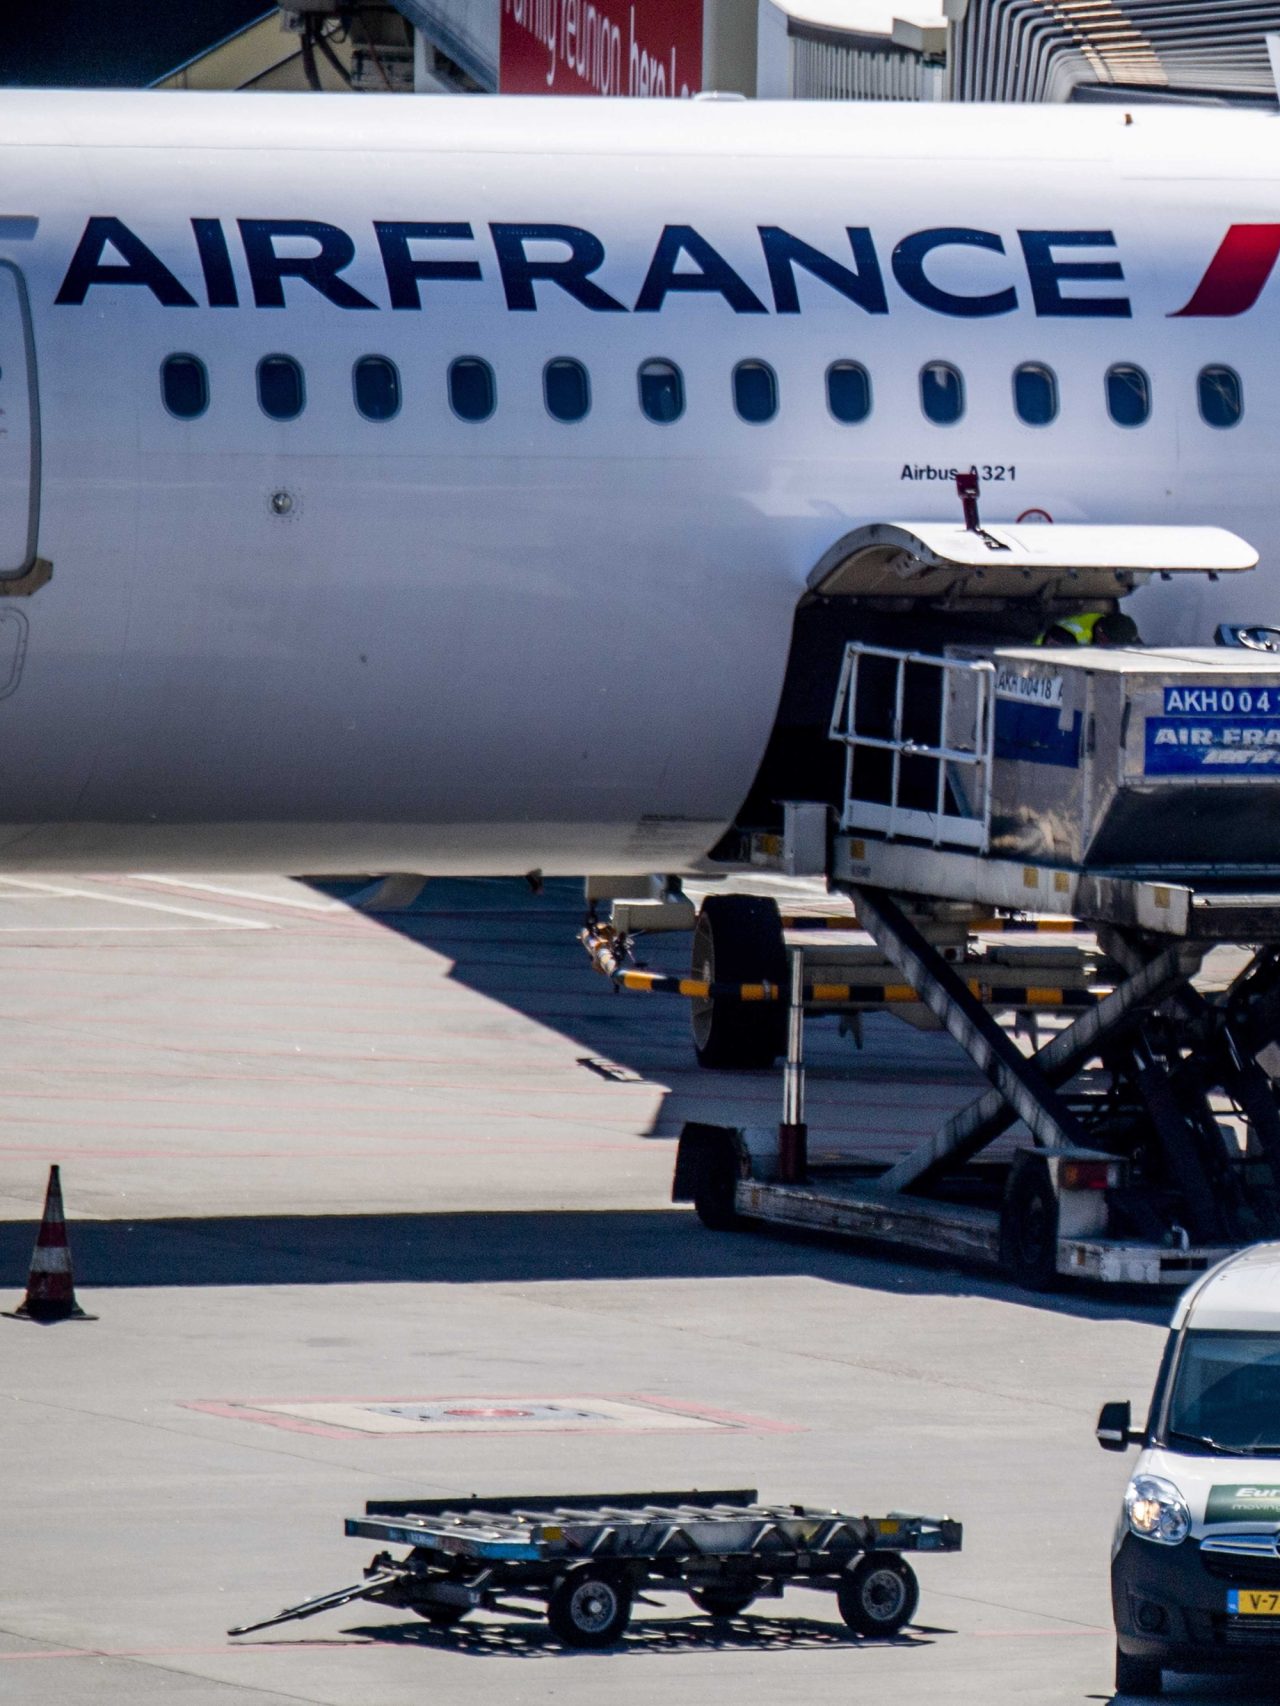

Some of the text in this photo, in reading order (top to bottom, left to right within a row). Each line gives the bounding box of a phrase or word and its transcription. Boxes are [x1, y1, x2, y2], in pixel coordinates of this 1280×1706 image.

[54, 215, 1133, 318] AIRFRANCE
[900, 464, 1016, 481] Airbus A321
[1154, 728, 1213, 746] AIR
